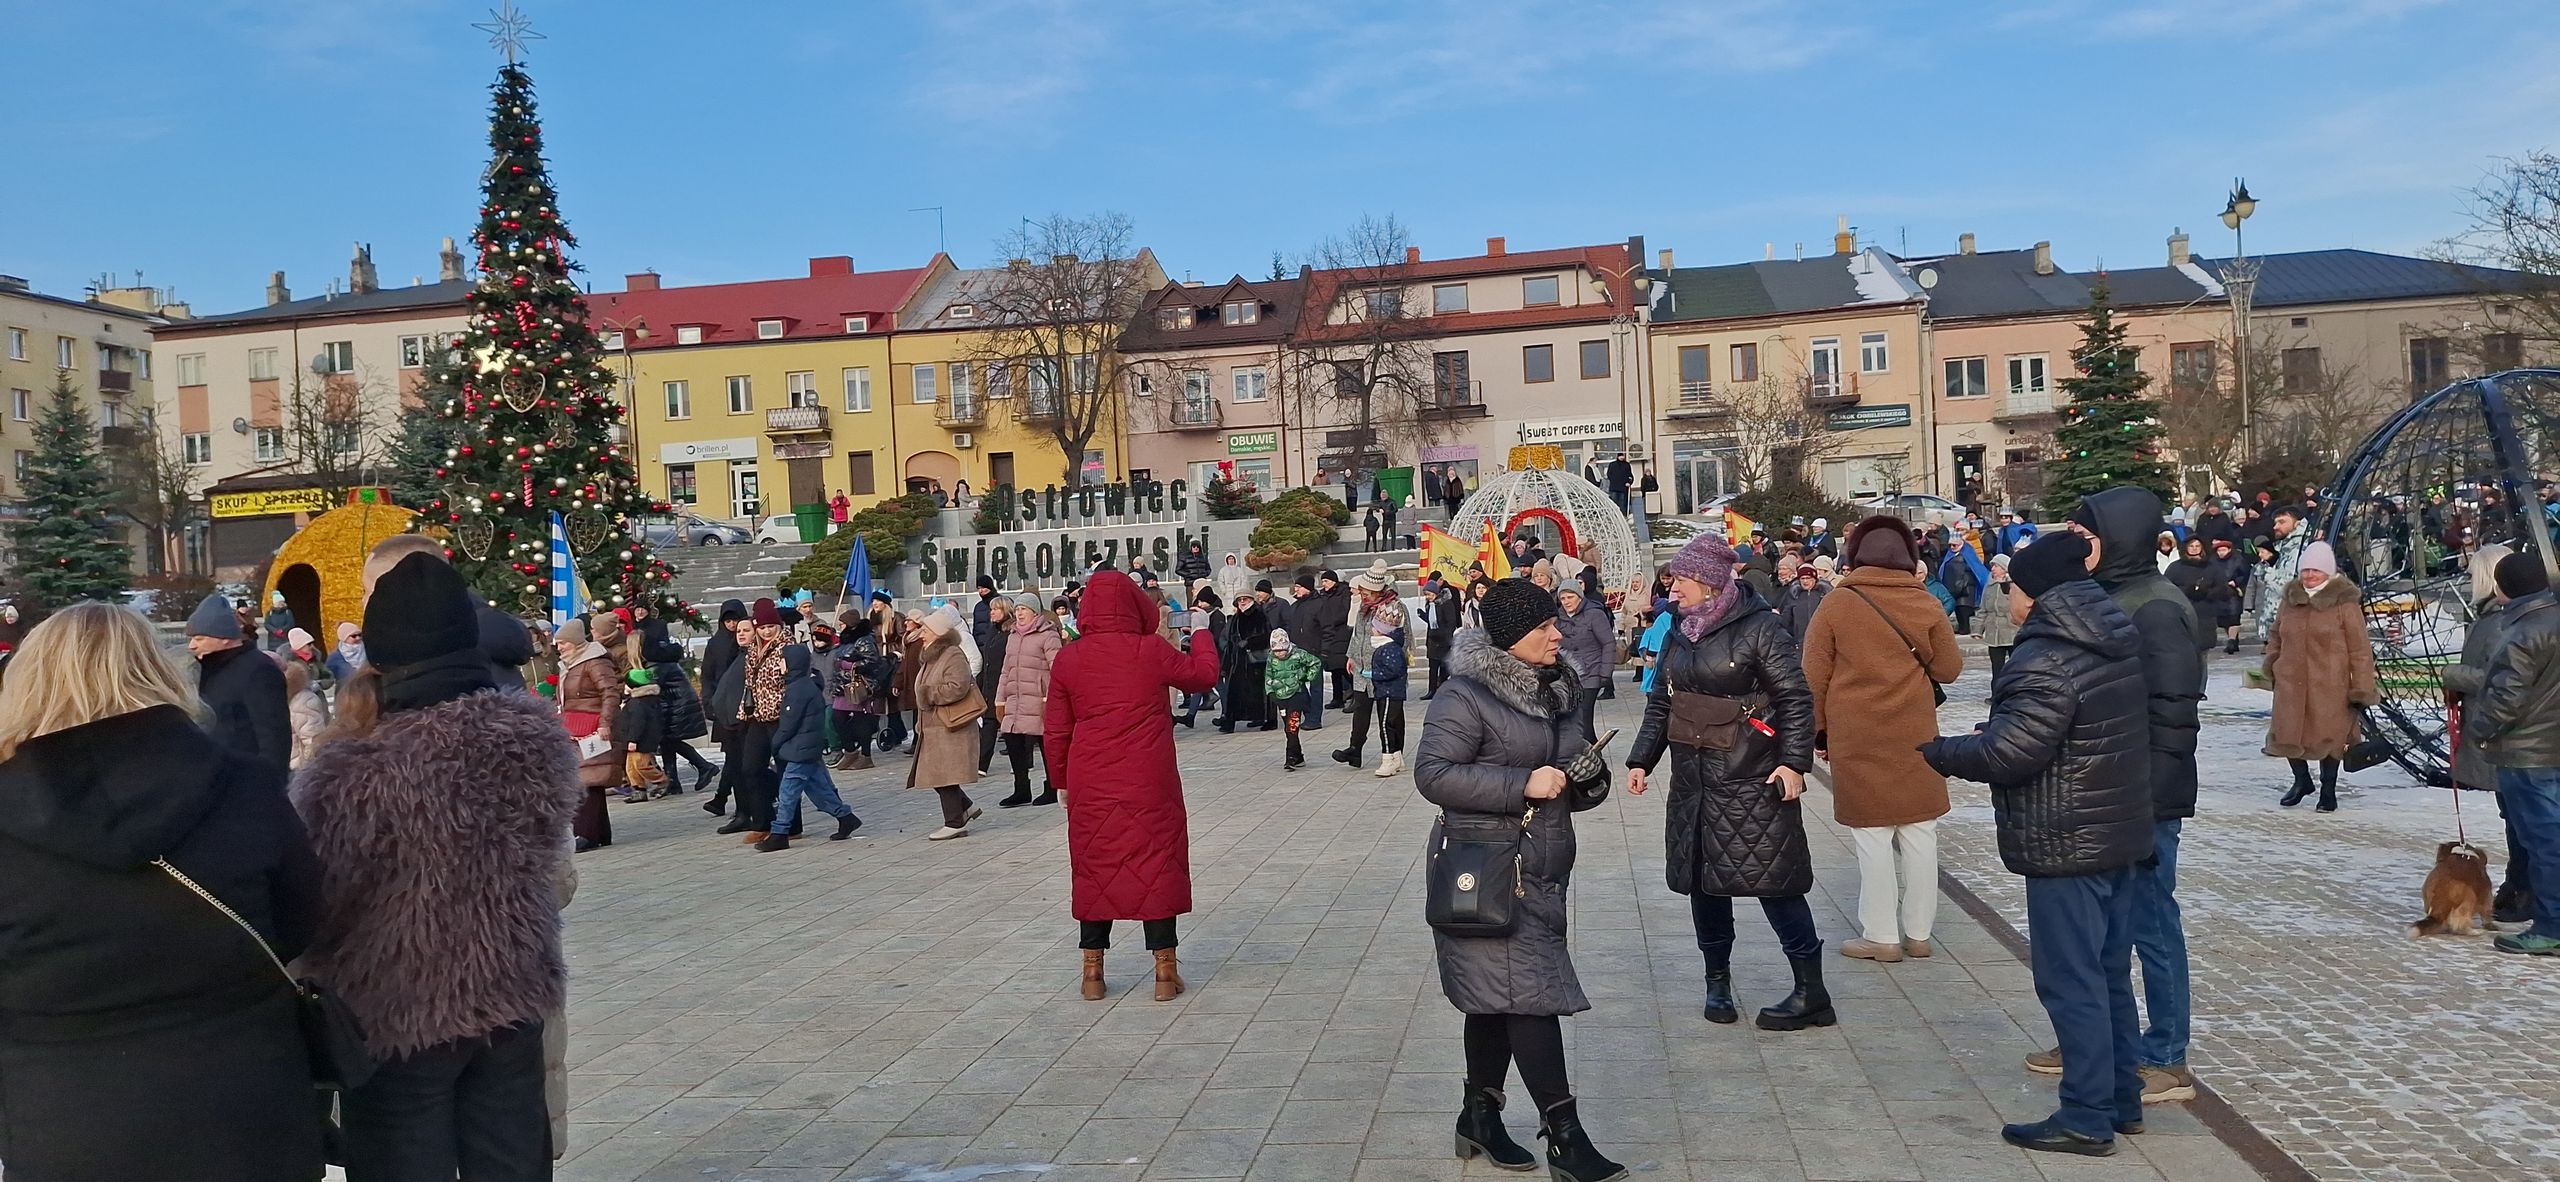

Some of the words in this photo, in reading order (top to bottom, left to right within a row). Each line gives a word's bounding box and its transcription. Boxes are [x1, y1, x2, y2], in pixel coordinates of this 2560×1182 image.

[1527, 428, 1558, 438] SWEET
[1562, 425, 1595, 435] COFFEE
[1599, 423, 1622, 432] ZONE
[1230, 434, 1275, 446] OBUWIE
[696, 444, 729, 454] brillen.pl
[216, 497, 248, 509] SKUP
[265, 492, 320, 506] SPRZEDA
[1000, 478, 1187, 523] Ostrowiec
